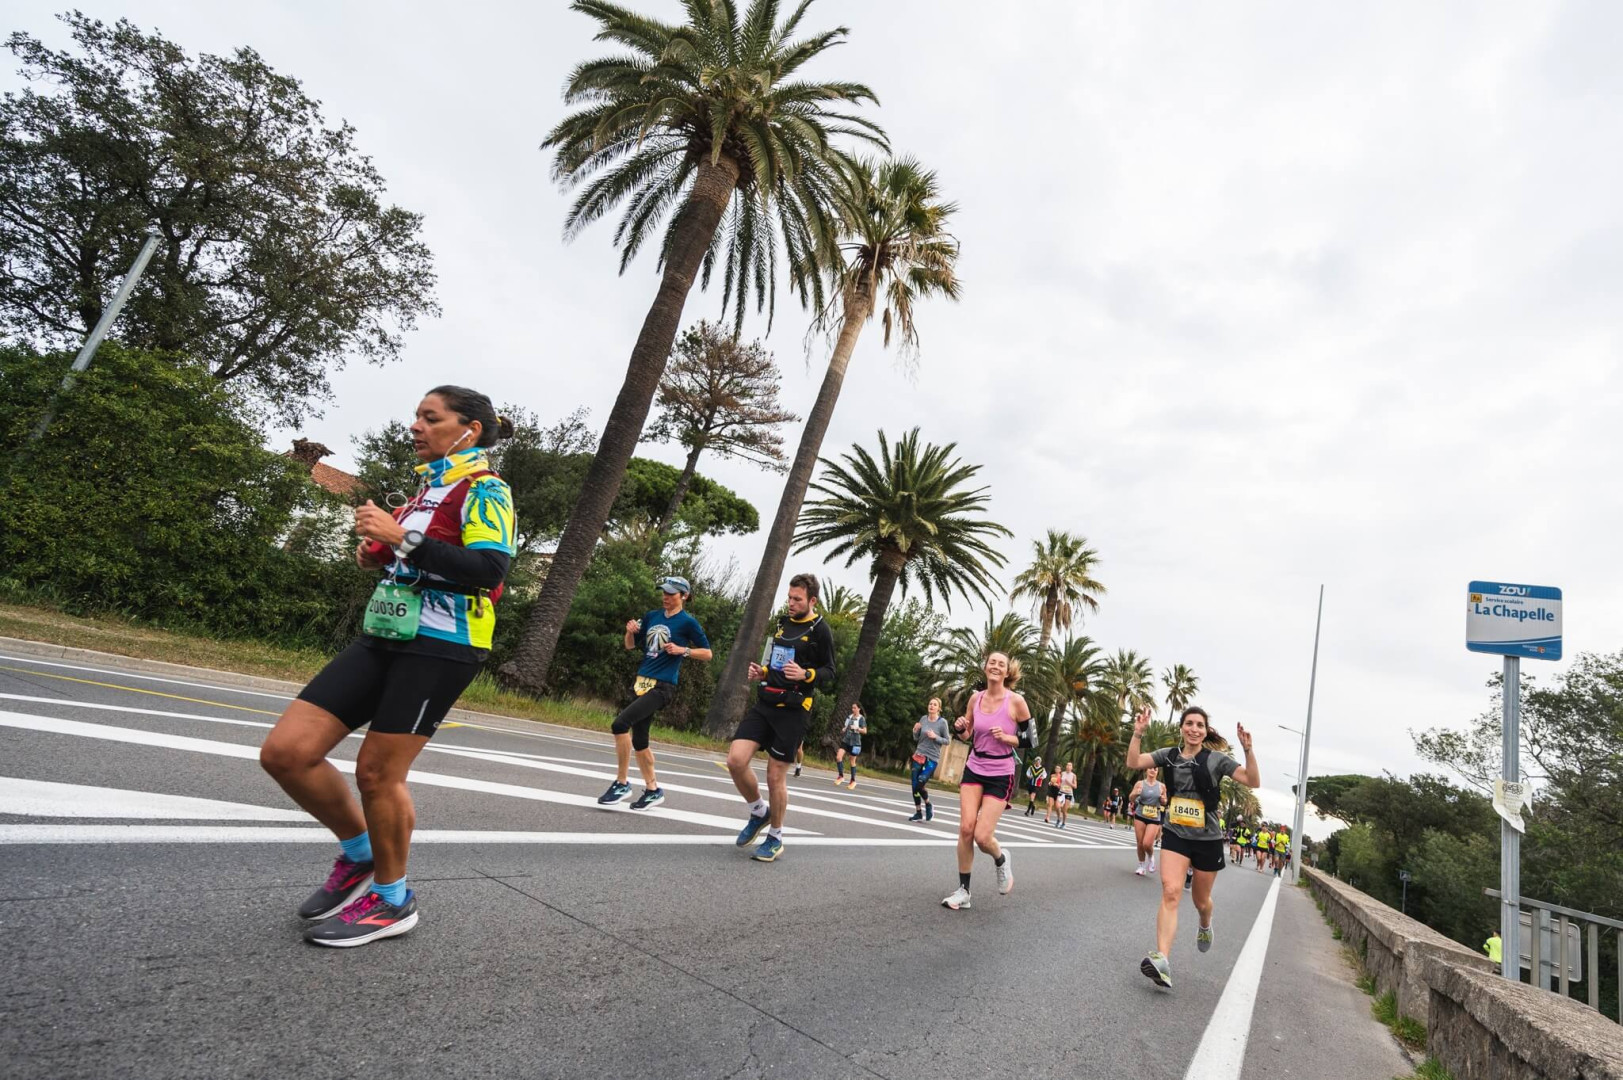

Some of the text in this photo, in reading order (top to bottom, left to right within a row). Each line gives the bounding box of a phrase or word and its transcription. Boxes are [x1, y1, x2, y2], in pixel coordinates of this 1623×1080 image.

[369, 599, 407, 617] 20036
[1475, 603, 1555, 622] La Chapelle
[1174, 805, 1200, 816] 18405
